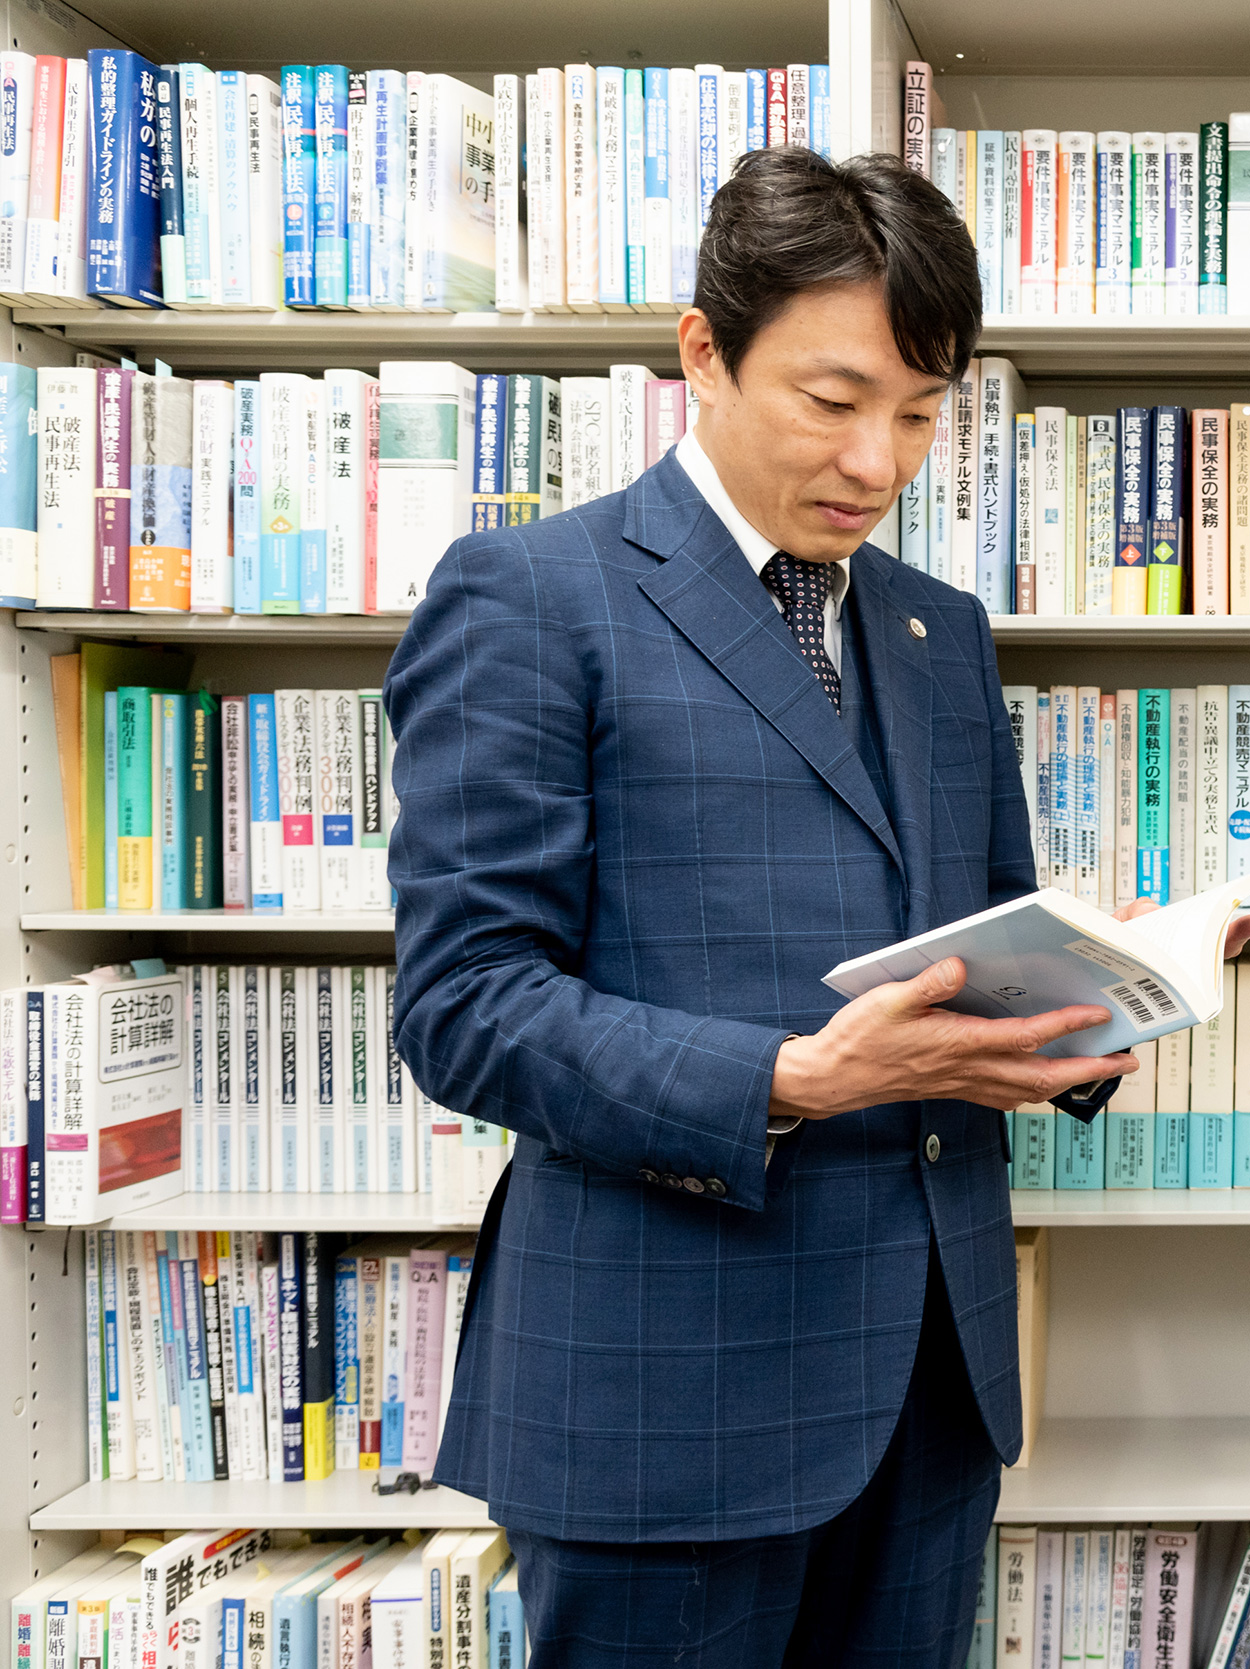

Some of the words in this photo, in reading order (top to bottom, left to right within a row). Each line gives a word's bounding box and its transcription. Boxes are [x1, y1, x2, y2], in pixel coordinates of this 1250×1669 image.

[97, 56, 118, 224] 私的整理ガイドラインの実務
[159, 106, 175, 189] 民事再生法入門
[249, 116, 261, 174] 民事再生法
[375, 91, 388, 185] 再生計画事例集
[1004, 137, 1018, 240] 民事尋問技術
[984, 142, 996, 250] 証拠・資料収集マニュアル
[1035, 149, 1051, 265] 要件事実マニュアル
[1072, 152, 1087, 267] 要件事実マニュアル
[1109, 152, 1125, 266] 要件事実マニュアル
[1145, 152, 1160, 266] 要件事実マニュアル
[1179, 152, 1194, 266] 要件事実マニュアル
[1204, 123, 1223, 274] 文書提出命令の理論と実務
[141, 382, 157, 528] 破産管財人の財産換価
[333, 411, 352, 481] 破産法
[480, 377, 500, 494] 破産・民事再生の実務
[512, 377, 532, 494] 破産・民事再生の実務
[957, 382, 974, 521] 差止請求モデル文例集
[984, 378, 1000, 427] 民事執行
[1098, 421, 1107, 434] 6
[44, 416, 61, 509] 民事再生法
[982, 432, 1001, 554] 手続・書式ハンドブック
[1019, 428, 1031, 563] 仮差押え・仮処分の法律相談
[1044, 420, 1058, 499] 民事保全法
[1125, 417, 1143, 524] 民事保全の実務
[1156, 413, 1175, 521] 民事保全の実務
[1201, 417, 1218, 528] 民事保全の実務
[1236, 420, 1249, 528] 民事保全実務の諸問題
[1098, 478, 1113, 568] 民事保全の実務
[121, 697, 136, 750] 商取引法
[292, 695, 313, 813] 企業法務判例
[334, 695, 355, 813] 企業法務判例
[1056, 704, 1069, 810] 不動産執行の理論と実務
[1083, 706, 1096, 813] 不動産執行の理論と実務
[1121, 703, 1133, 827] 不良債権回収と知能暴力犯罪
[1145, 695, 1161, 808] 不動産執行の実務
[1177, 704, 1189, 804] 不動産配当の諸問題
[1203, 701, 1218, 836] 抗告・異議申立ての実務と書式
[1235, 700, 1250, 809] 不動産競売マニュアル
[1037, 763, 1050, 853] 不動産競売のすべて
[63, 993, 85, 1131] 会社法の計算詳解
[110, 994, 173, 1025] 会社法の
[110, 1020, 174, 1056] 計算詳解
[216, 988, 231, 1104] 会社法コンメンタール
[244, 988, 260, 1104] 会社法コンメンタール
[281, 989, 297, 1104] 会社法コンメンタール
[318, 989, 333, 1104] 会社法コンメンタール
[351, 989, 367, 1104] 会社法コンメンタール
[145, 1567, 159, 1631] 誰でもできる
[165, 1530, 273, 1617] 誰でもできる
[1007, 1551, 1025, 1602] 労働法
[1154, 1550, 1181, 1669] 労働安全衛生
